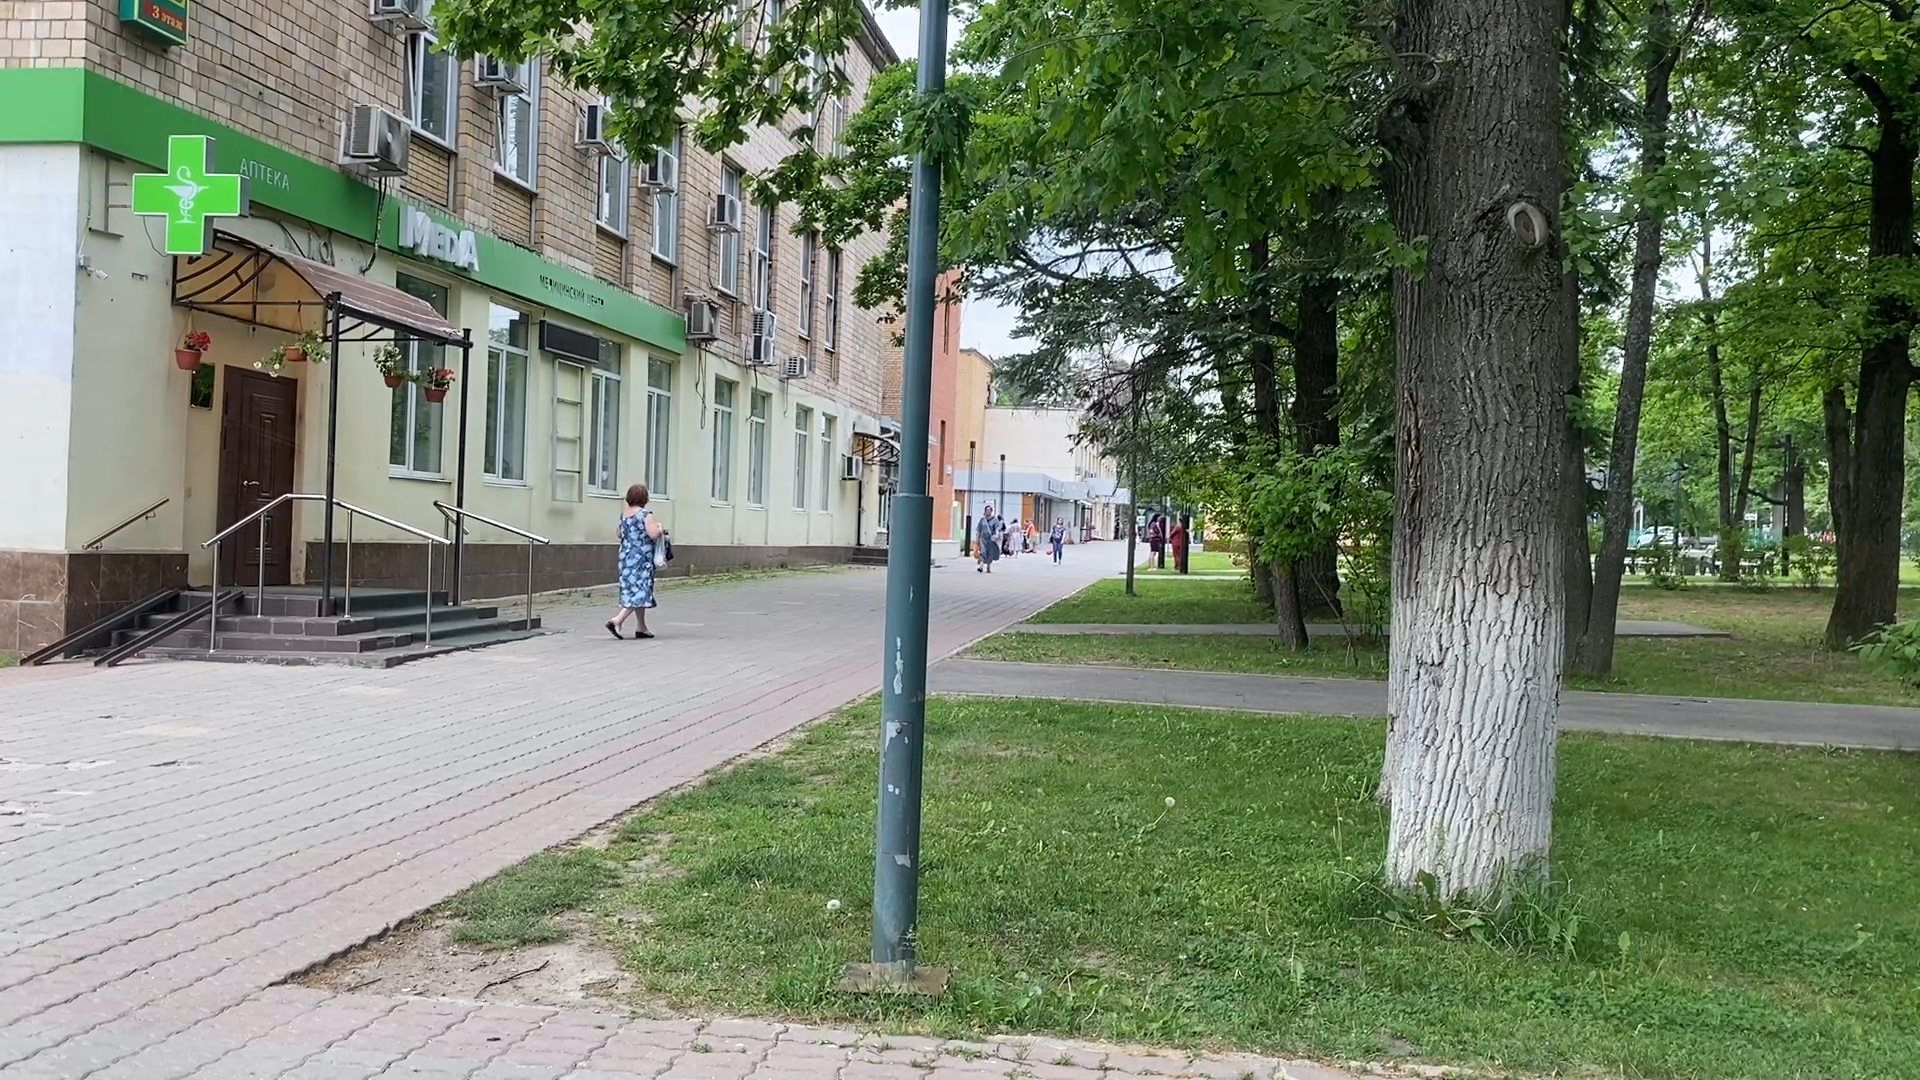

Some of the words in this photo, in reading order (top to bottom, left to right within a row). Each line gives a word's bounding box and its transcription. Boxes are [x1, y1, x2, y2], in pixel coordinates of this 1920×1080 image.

[152, 5, 160, 19] 3
[161, 12, 183, 31] этаж
[240, 157, 290, 191] АПТЕКА
[539, 274, 585, 303] МЕДИЦИНСКИЙ
